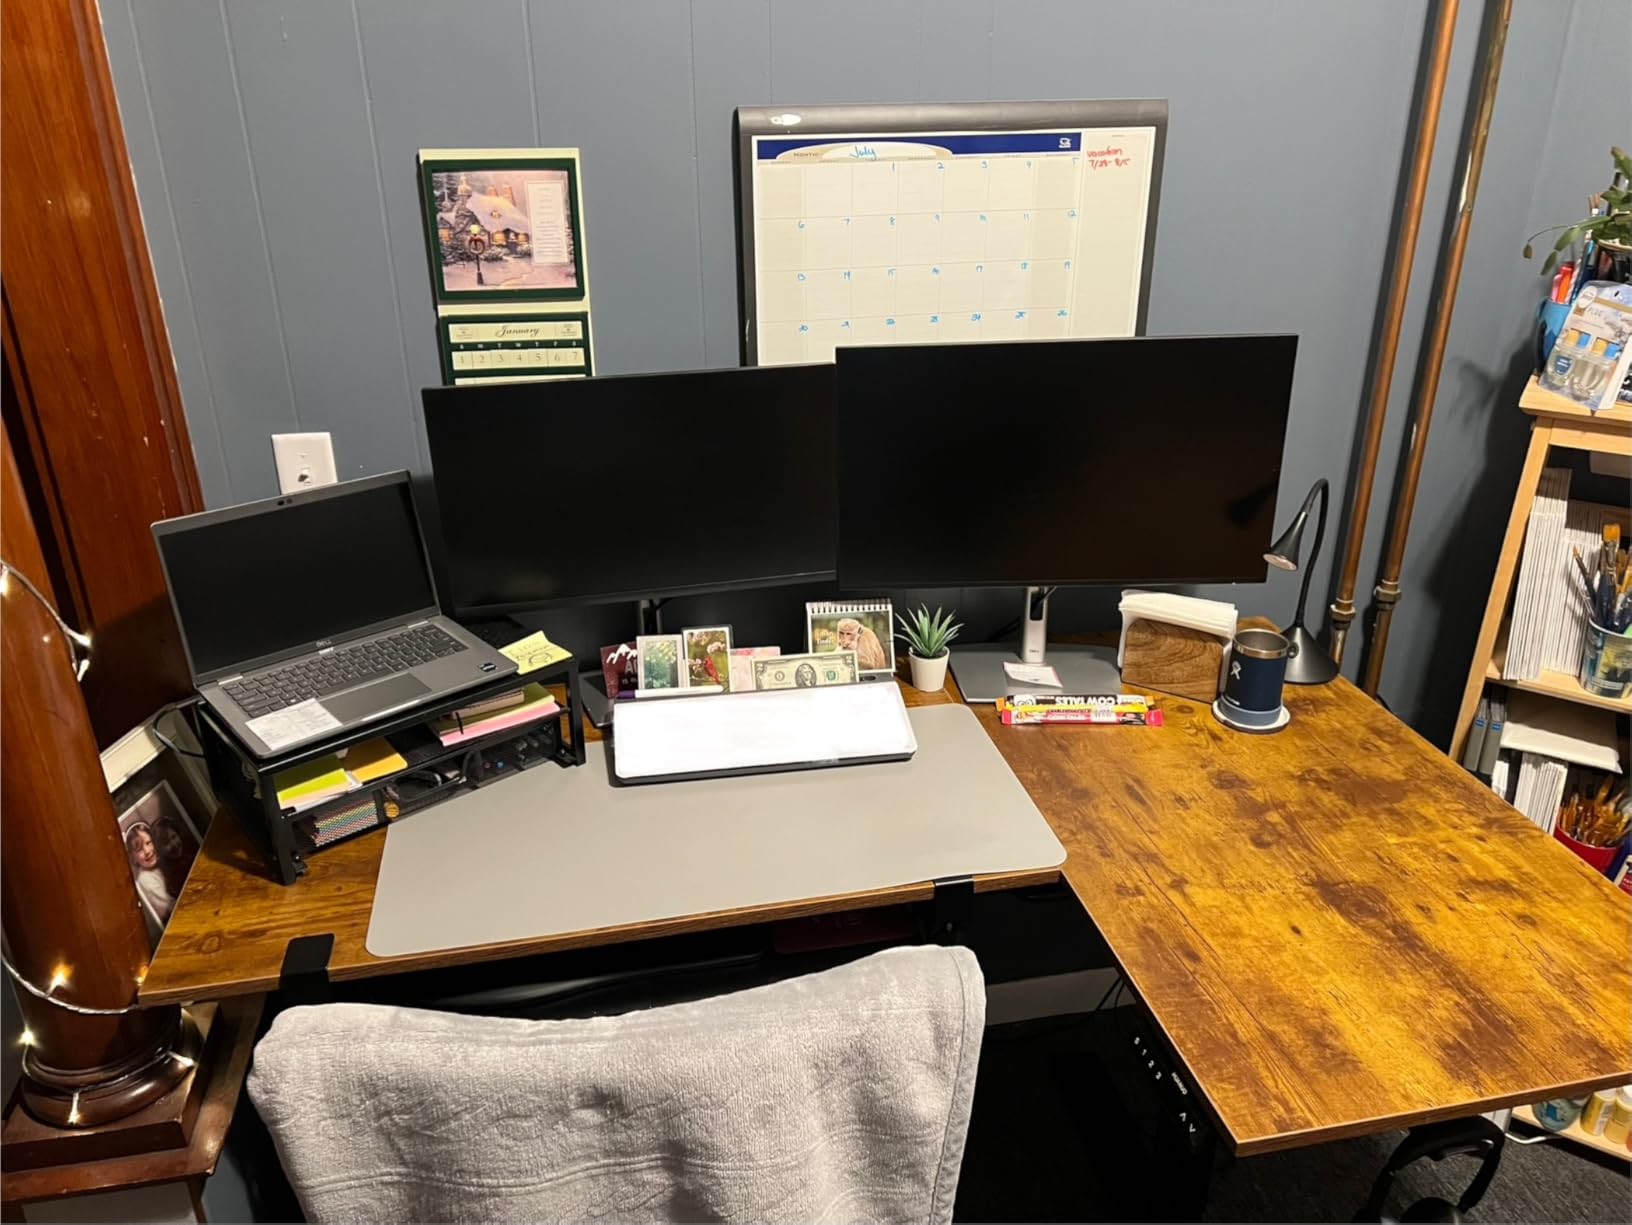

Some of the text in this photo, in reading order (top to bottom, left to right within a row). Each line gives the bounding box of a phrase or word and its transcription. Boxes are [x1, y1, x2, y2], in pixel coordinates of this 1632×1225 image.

[851, 147, 876, 161] July
[495, 325, 540, 338] January
[1055, 696, 1086, 706] TALES
[1086, 696, 1115, 706] COW
